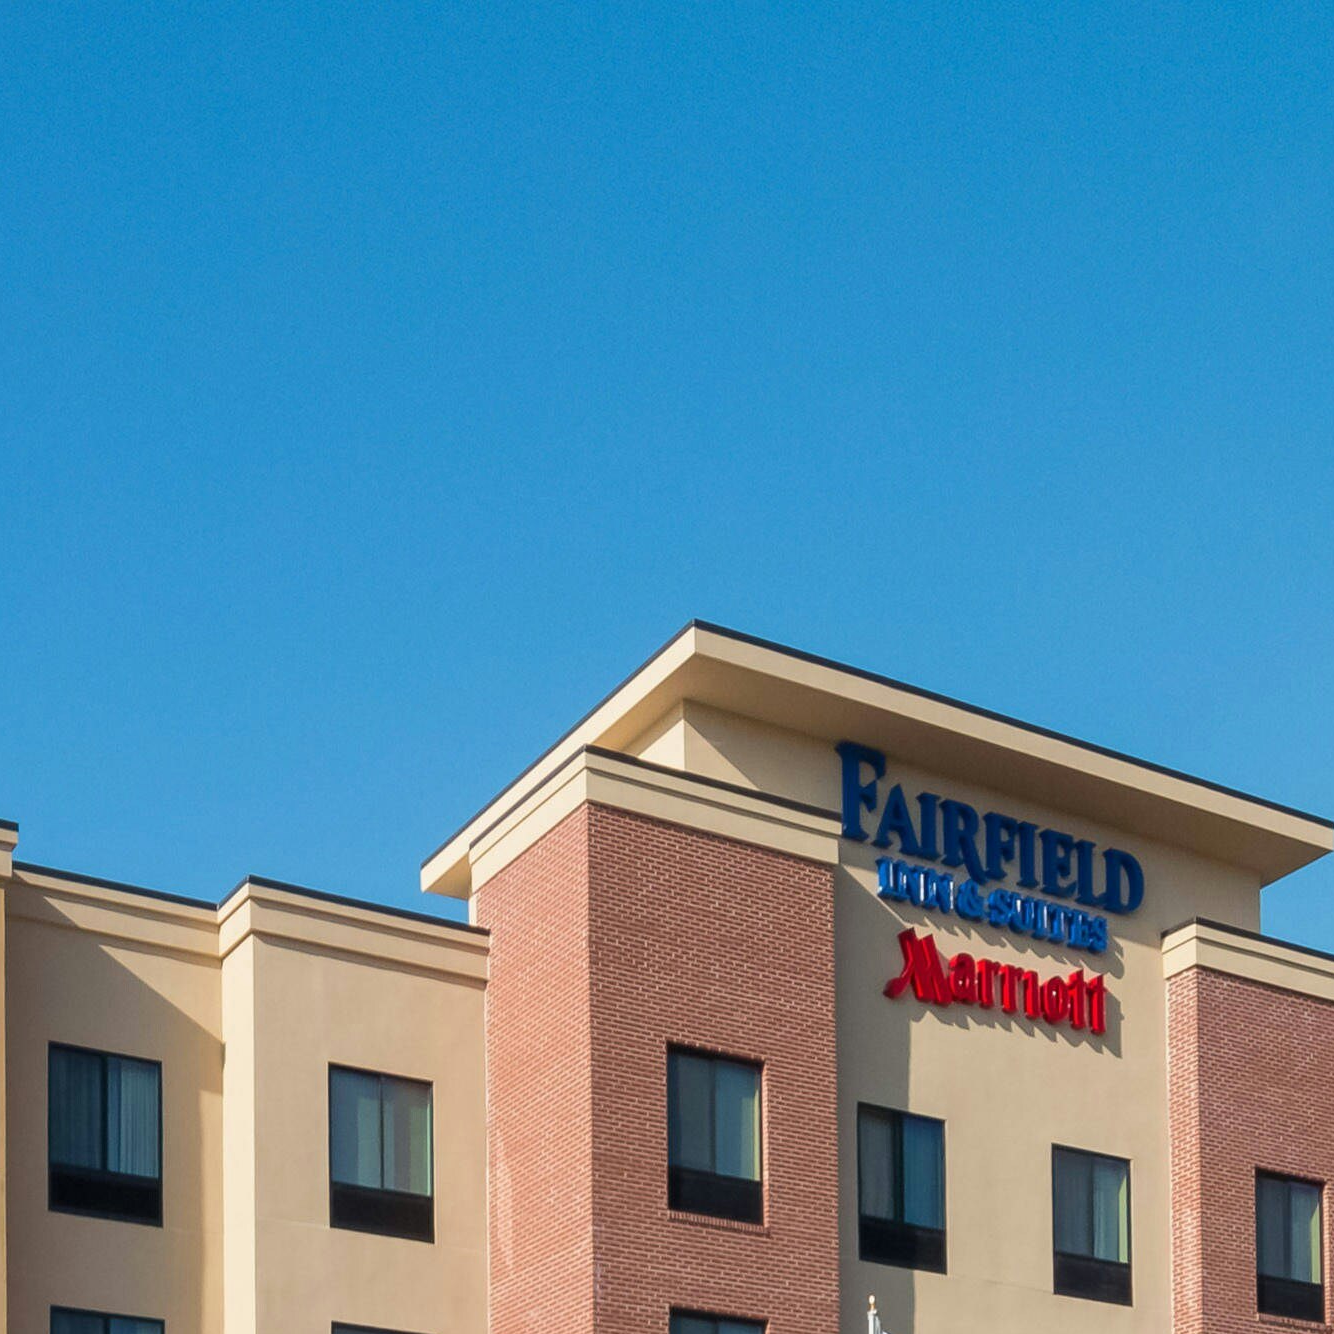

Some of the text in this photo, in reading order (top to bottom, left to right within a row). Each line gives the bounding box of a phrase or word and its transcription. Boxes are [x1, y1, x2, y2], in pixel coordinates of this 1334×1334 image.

[835, 741, 1144, 914] FAIRFIELD
[877, 857, 1108, 953] INN & SUITES
[883, 928, 1107, 1034] Marriott
